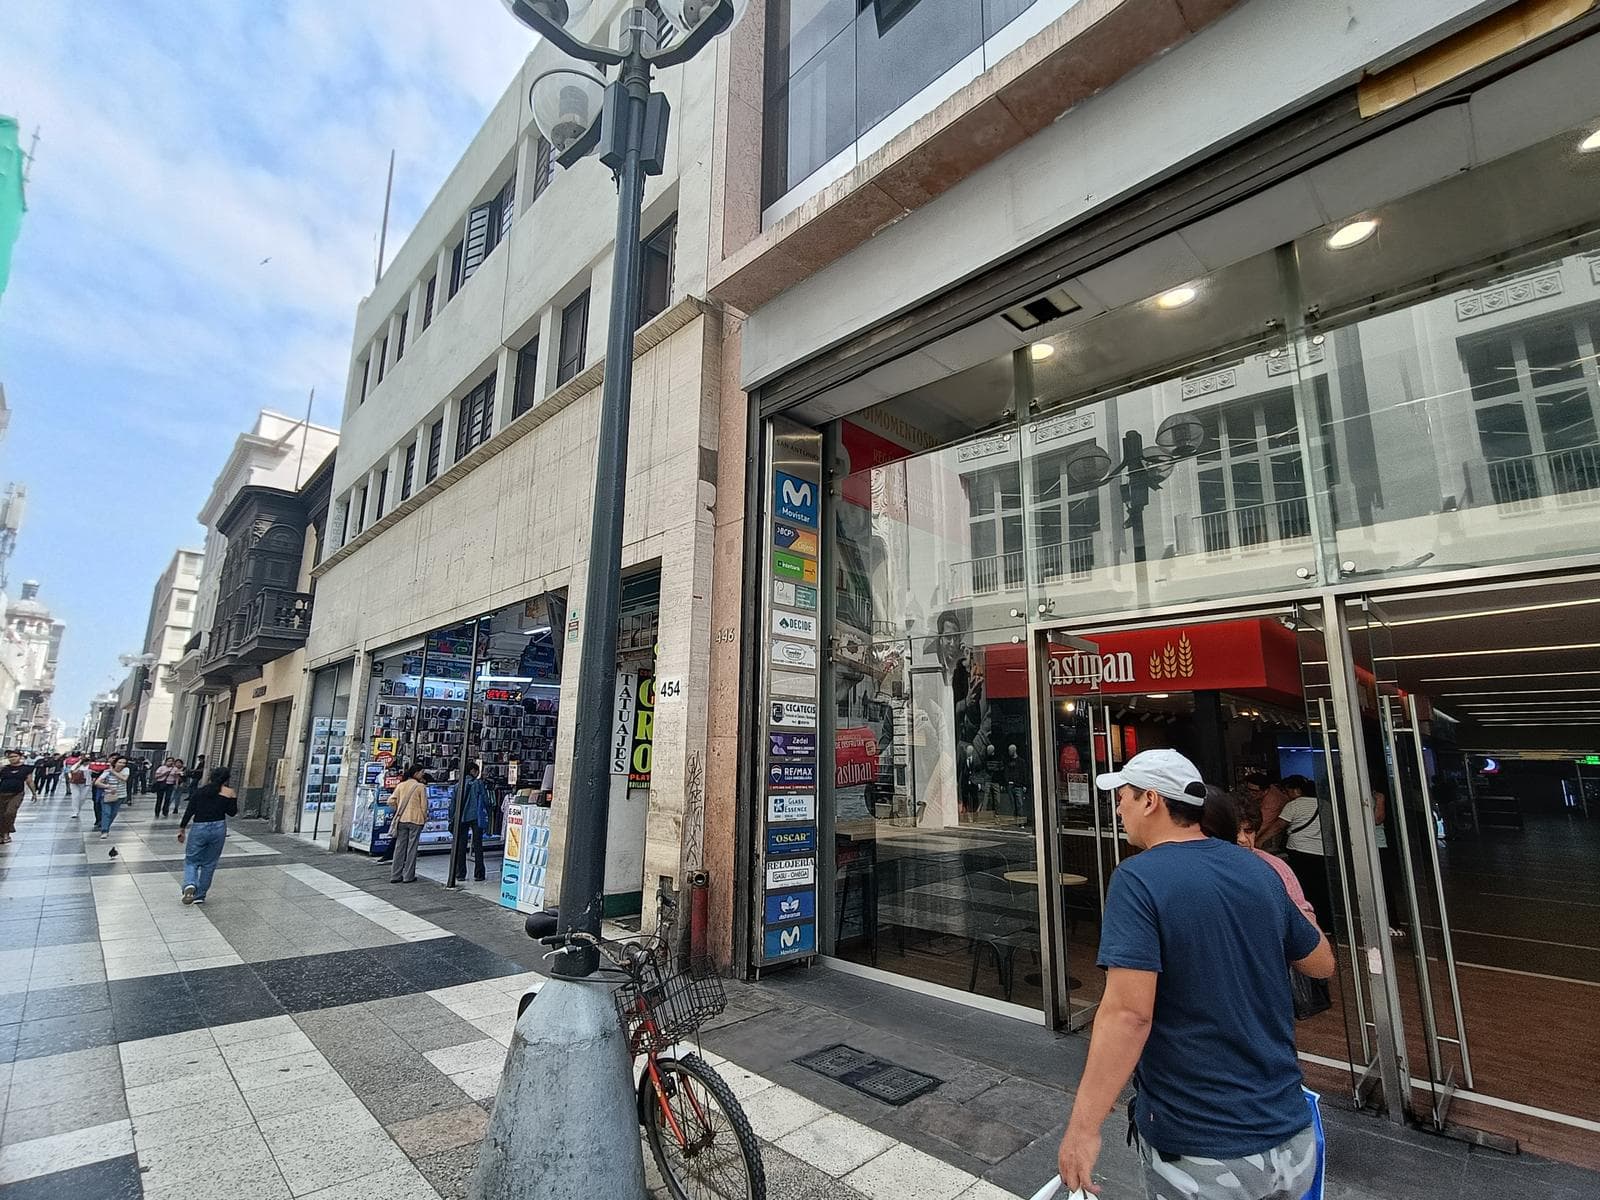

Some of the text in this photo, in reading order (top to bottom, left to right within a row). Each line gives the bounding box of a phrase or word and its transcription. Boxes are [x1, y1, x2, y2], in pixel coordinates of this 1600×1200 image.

[782, 506, 811, 523] Movistar
[779, 527, 793, 537] BCP
[789, 618, 812, 631] DECIDE
[714, 627, 736, 644] 446
[1049, 650, 1136, 691] astipan
[660, 680, 681, 698] 454
[613, 673, 634, 773] TATUAJES
[784, 767, 813, 776] RE/MAX
[837, 758, 873, 785] astipan
[767, 857, 815, 871] RELOJERIA
